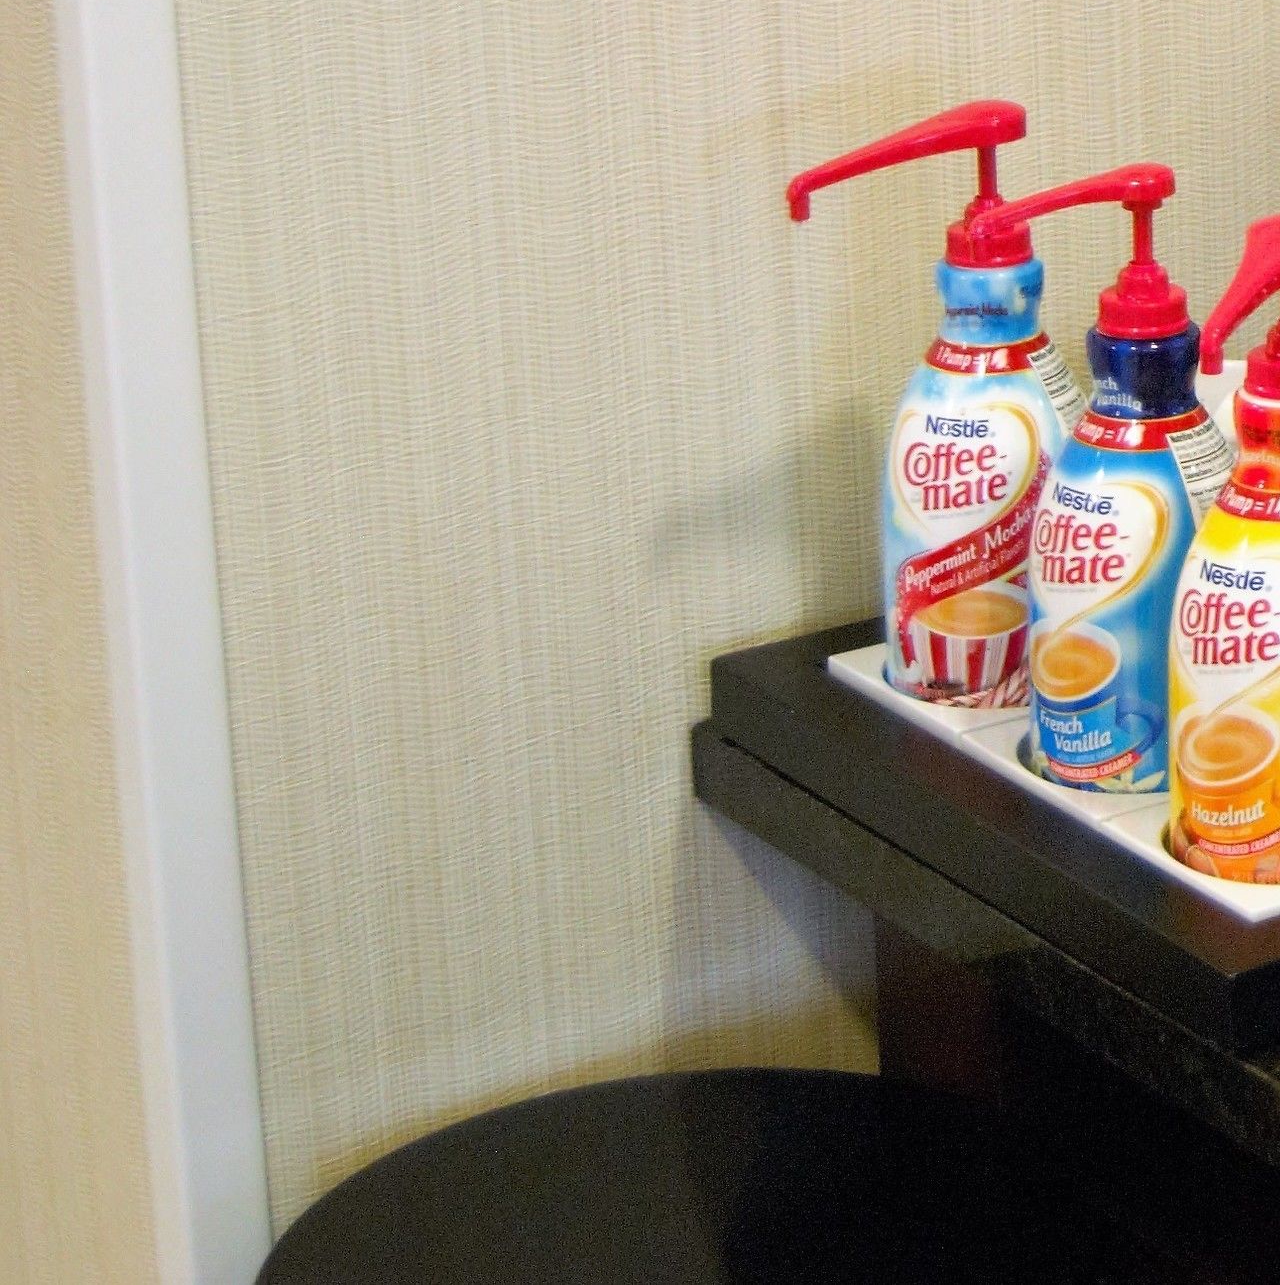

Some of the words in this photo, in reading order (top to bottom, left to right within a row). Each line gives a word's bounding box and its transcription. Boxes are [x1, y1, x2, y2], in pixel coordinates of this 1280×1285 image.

[922, 471, 1008, 512] mate
[905, 543, 977, 592] Peppermint
[1041, 552, 1125, 584] mate
[1192, 630, 1280, 665] mate
[1040, 709, 1083, 734] French
[1054, 730, 1112, 752] Vanilla
[1192, 799, 1265, 827] Hazelnut
